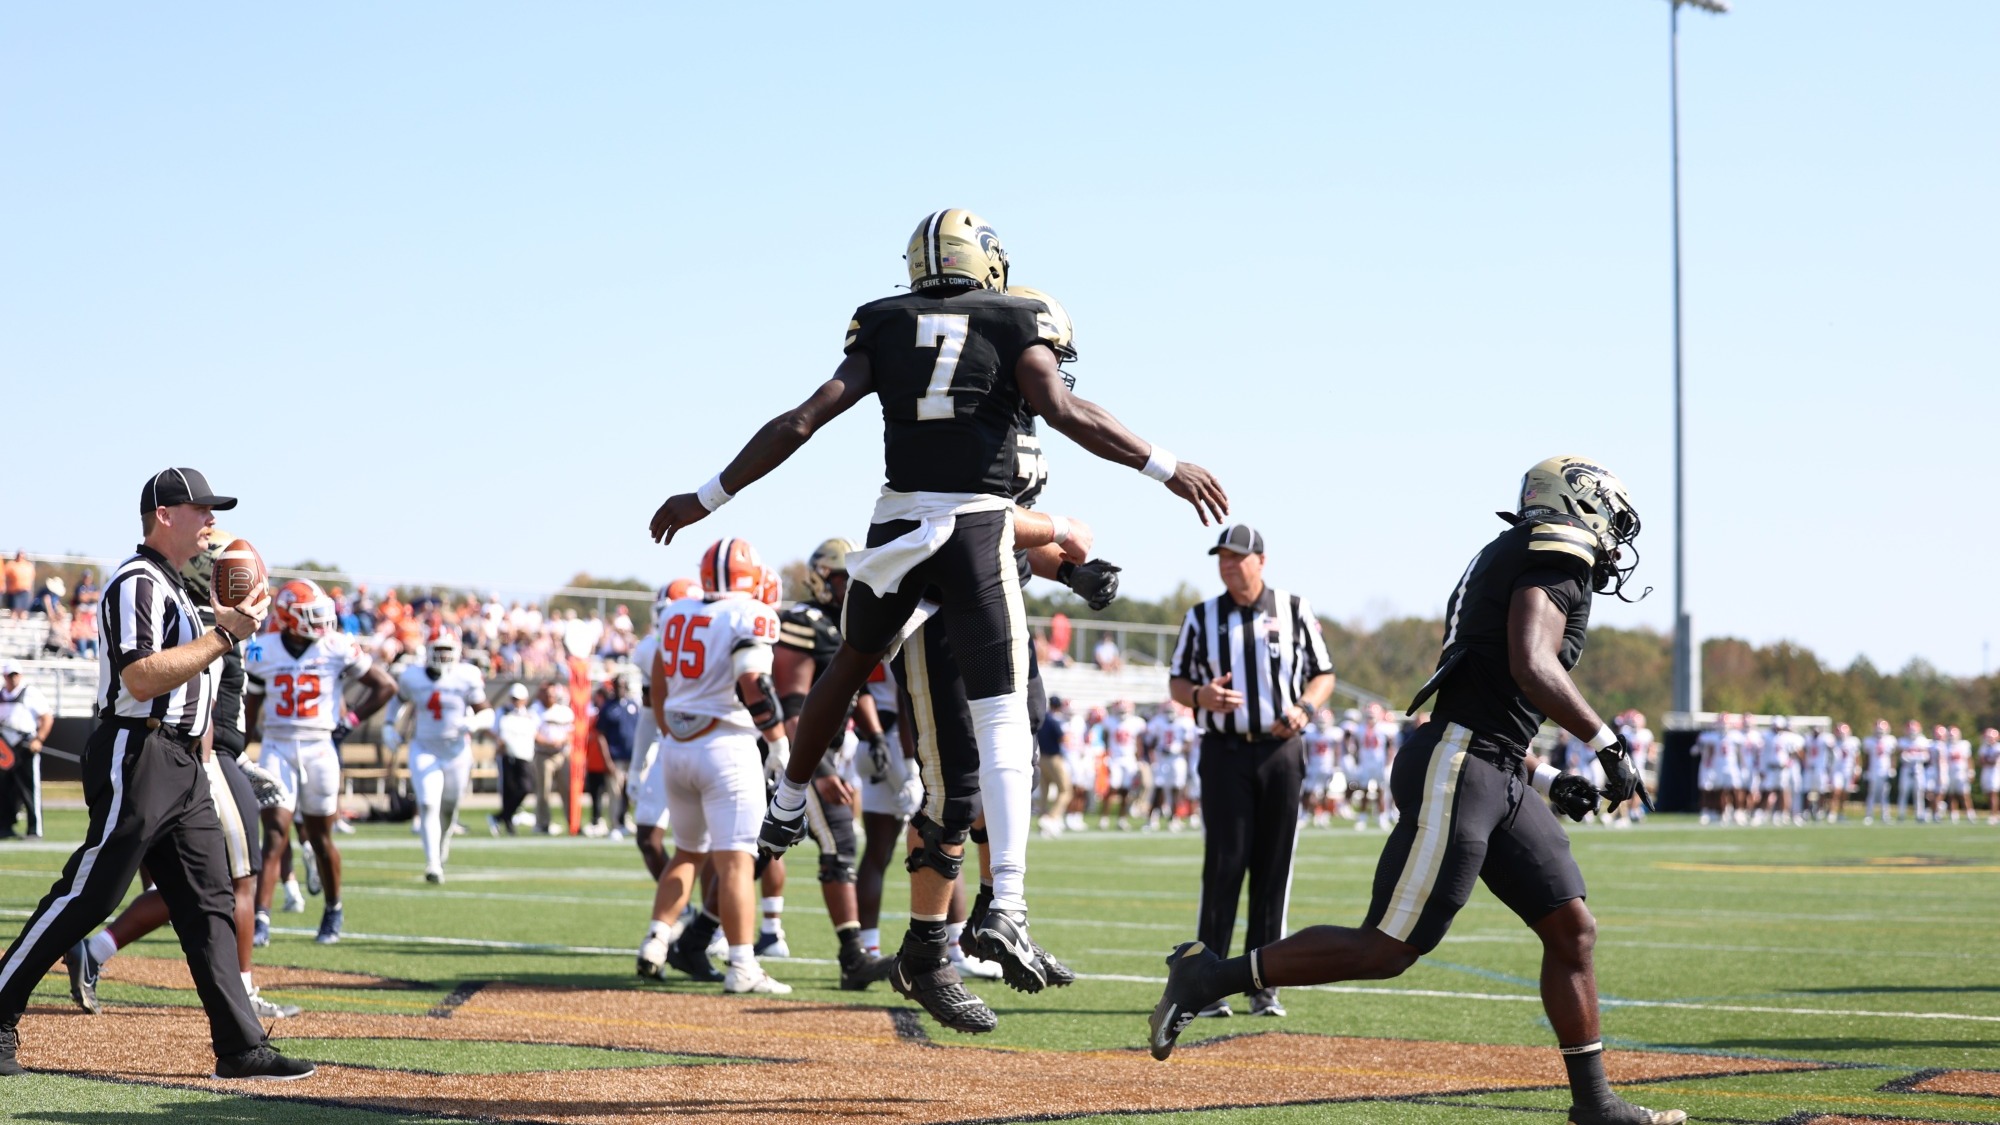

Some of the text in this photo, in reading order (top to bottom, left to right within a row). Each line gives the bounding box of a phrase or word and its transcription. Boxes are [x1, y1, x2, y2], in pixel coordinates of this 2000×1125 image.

[922, 278, 940, 288] SERVE
[948, 277, 978, 287] COMPETE
[915, 313, 969, 421] 7
[1525, 508, 1551, 518] COMPETE
[663, 613, 713, 680] 95
[274, 672, 321, 718] 32
[426, 689, 443, 722] 4
